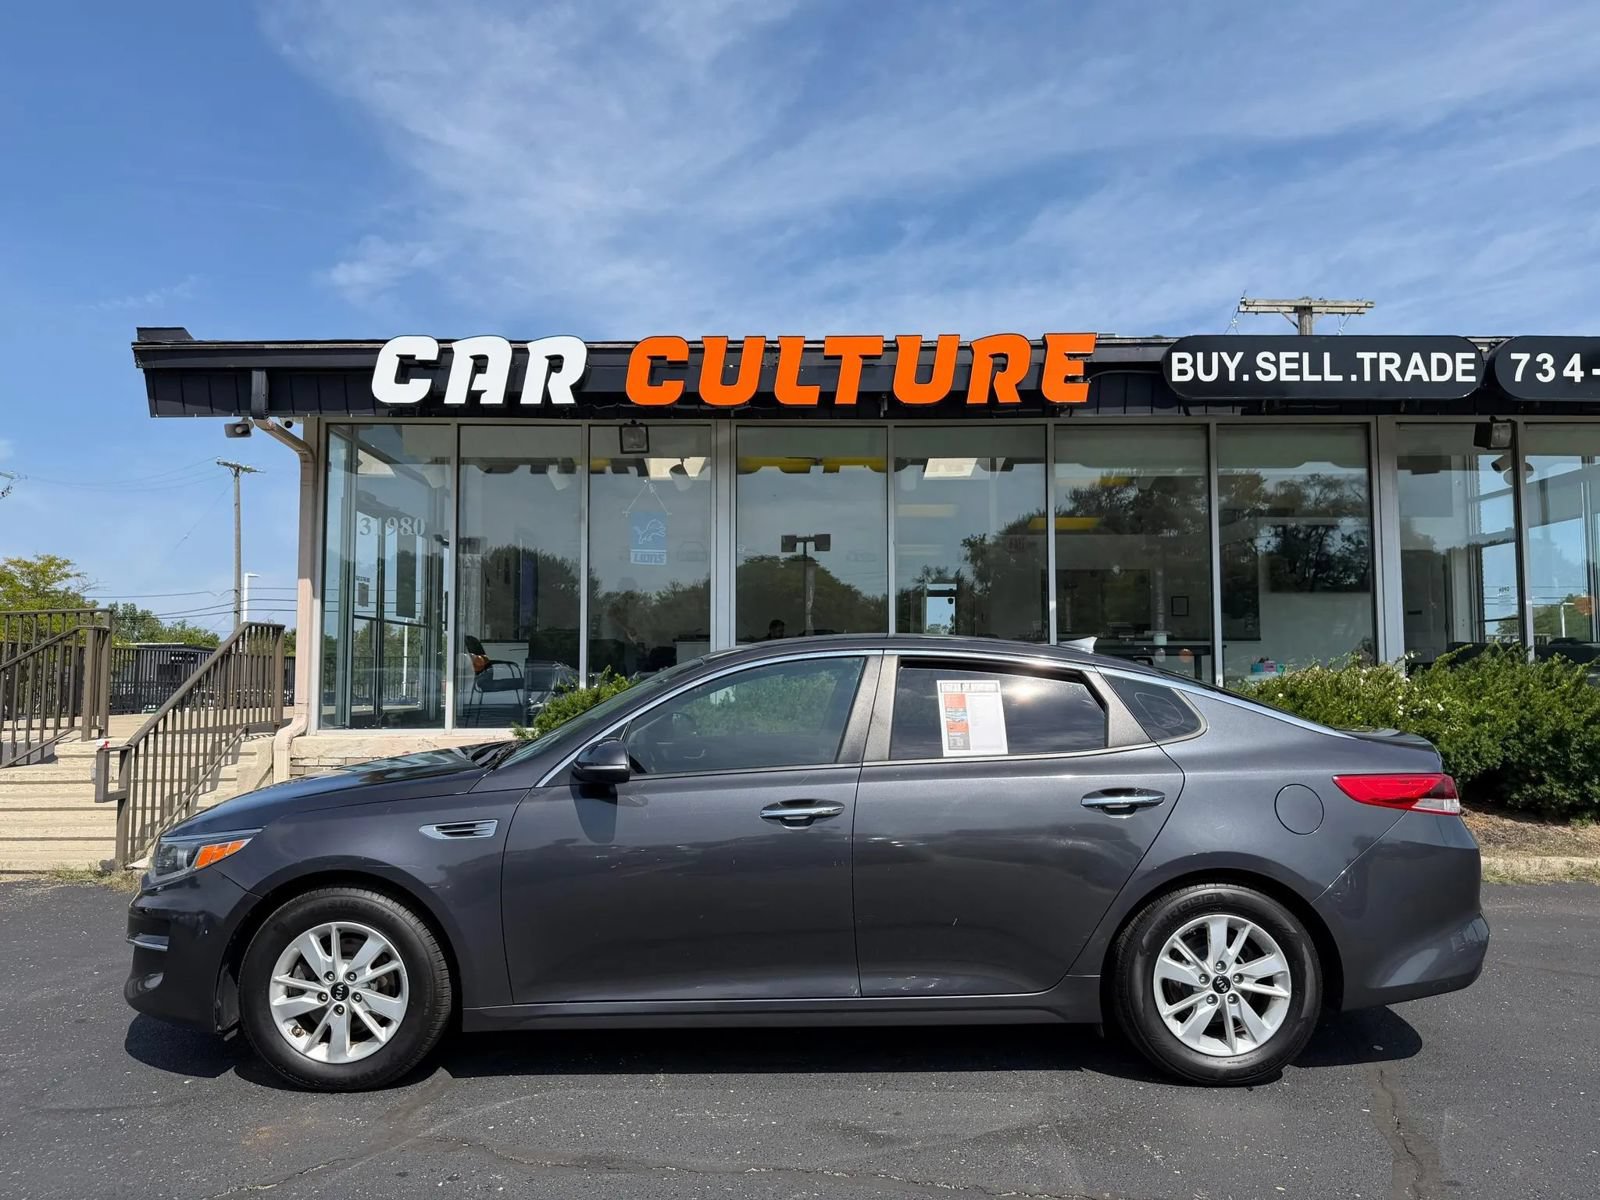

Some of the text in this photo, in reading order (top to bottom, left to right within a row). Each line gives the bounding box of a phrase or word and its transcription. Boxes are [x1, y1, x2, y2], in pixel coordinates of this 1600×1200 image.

[371, 333, 1096, 406] CAR CULTURE
[359, 516, 426, 537] 31980
